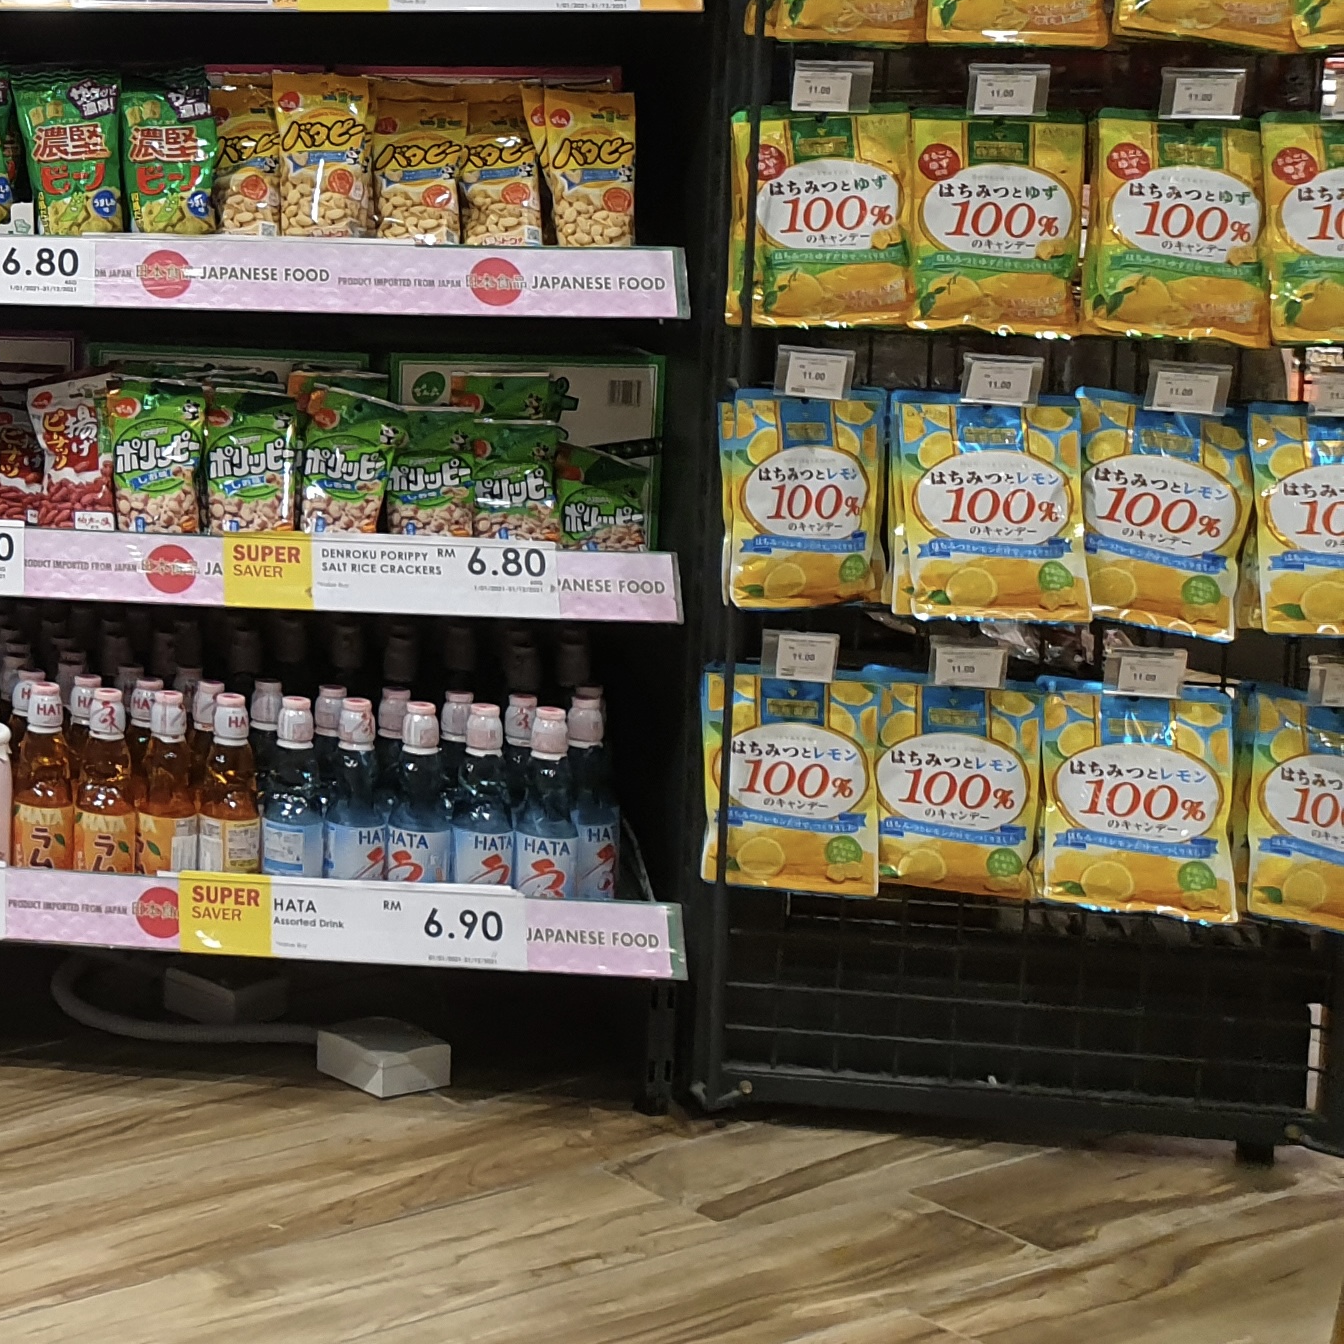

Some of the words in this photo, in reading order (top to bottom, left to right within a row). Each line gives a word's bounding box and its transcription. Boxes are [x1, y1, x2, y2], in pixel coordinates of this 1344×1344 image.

[2, 248, 78, 277] 6.80
[532, 276, 611, 290] JAPANESE
[618, 276, 666, 291] FOOD
[930, 469, 1060, 486] はちみつとレモン
[945, 488, 1058, 524] 100%
[322, 562, 347, 573] SALT
[351, 563, 377, 574] RICE
[380, 564, 441, 575] CRACKERS
[897, 769, 1014, 810] 100%
[524, 837, 571, 856] HATA
[192, 886, 260, 907] SUPER
[192, 906, 241, 921] SAVER
[273, 898, 317, 914] HATA
[273, 917, 314, 928] Assorted
[318, 918, 344, 929] Drink
[424, 908, 502, 942] 6.90
